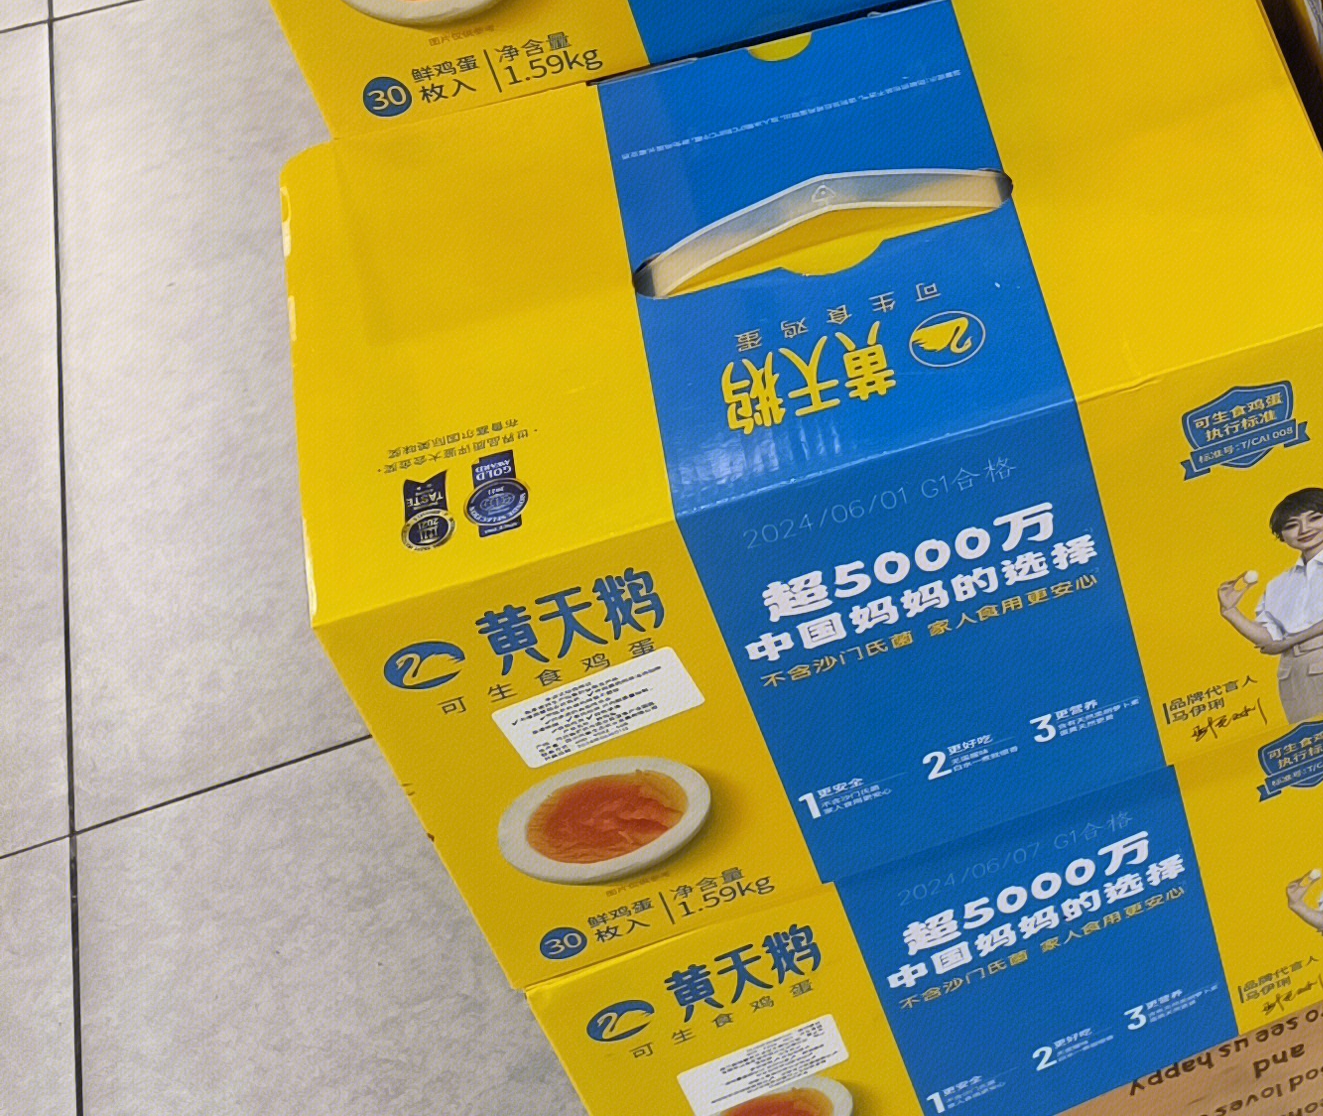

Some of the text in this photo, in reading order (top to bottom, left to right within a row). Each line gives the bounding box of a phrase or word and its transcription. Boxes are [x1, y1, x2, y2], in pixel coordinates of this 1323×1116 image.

[368, 28, 572, 110] 30 鲜鸡蛋 净含量
[419, 46, 603, 105] 枚入 1.59kg
[735, 280, 942, 354] 可生食鸡蛋
[720, 318, 899, 437] 黄天鹅
[1193, 391, 1284, 430] 可生食鸡蛋
[1205, 412, 1278, 443] 执行标准
[1271, 426, 1294, 440] 008
[743, 455, 1017, 551] 2024/06/01 G1合格
[761, 501, 1055, 624] 超5000万
[475, 566, 666, 677] 黄天鹅
[744, 532, 1100, 666] 中国妈妈的选择
[760, 572, 1100, 690] 不含沙门氏菌 家人食用更安心
[437, 636, 657, 717] 可生食鸡蛋
[1169, 674, 1259, 711] 品牌代言人
[946, 734, 995, 756] 更好吃
[1029, 712, 1058, 743] 3
[816, 776, 865, 800] 更安全
[922, 750, 953, 781] 2
[798, 792, 822, 820] 1
[1053, 811, 1135, 856] G1合格
[543, 864, 745, 955] 30 鲜鸡蛋 净含量
[593, 874, 776, 945] 枚入 1.59kg
[902, 829, 1154, 959] 超5000万
[885, 852, 1188, 991] 中国妈妈的选择
[898, 885, 1187, 1011] 不含沙门氏菌 家人食用更安心
[662, 922, 824, 1025] 黄天鹅
[628, 978, 818, 1061] 可生食鸡蛋
[1124, 1004, 1147, 1031] 3
[1256, 1015, 1299, 1043] see
[1032, 1046, 1058, 1072] 2
[1217, 1037, 1249, 1058] us
[1252, 1042, 1306, 1079] and
[1129, 1051, 1216, 1097] happy
[926, 1091, 947, 1114] 1
[1214, 1083, 1283, 1116] loves
